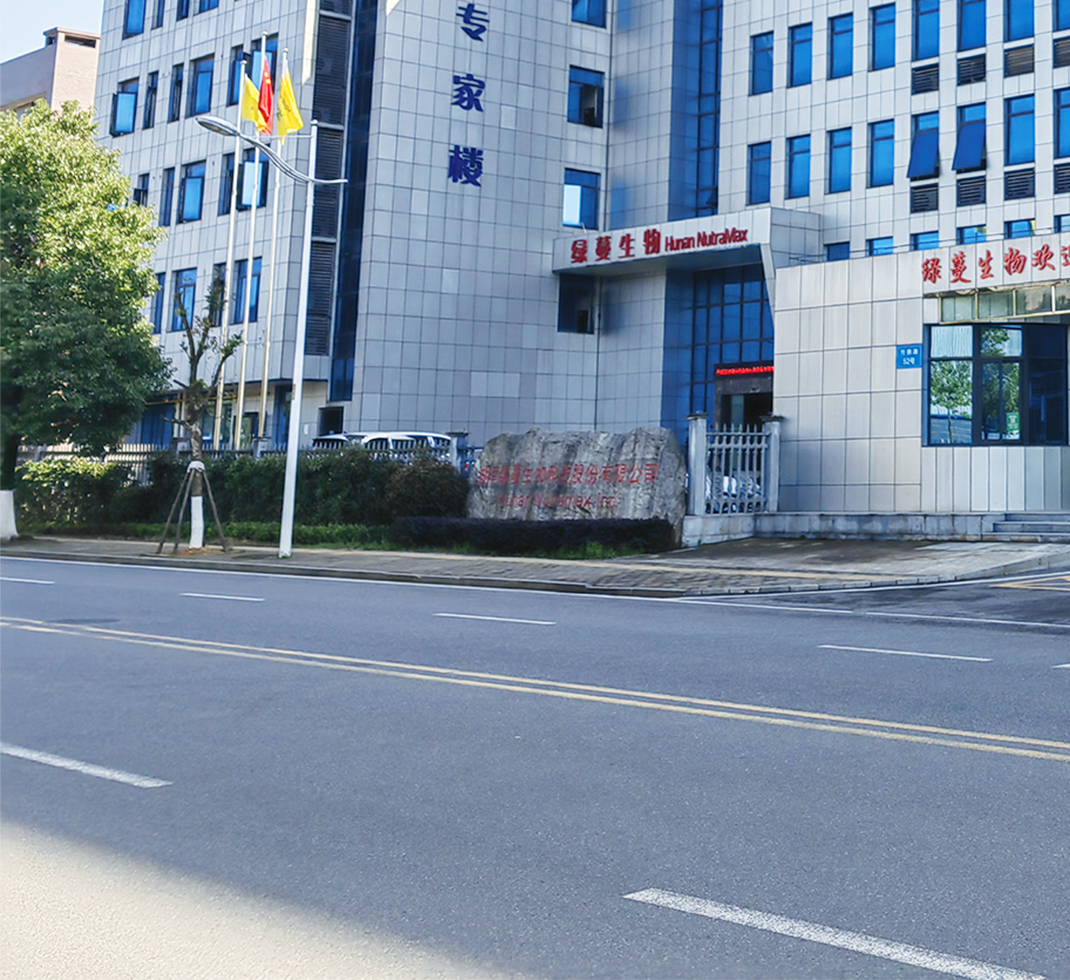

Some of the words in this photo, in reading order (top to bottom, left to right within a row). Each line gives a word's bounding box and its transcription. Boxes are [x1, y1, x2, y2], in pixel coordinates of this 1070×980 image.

[447, 3, 490, 187] 专家楼
[571, 228, 661, 264] 绿蔓生物
[665, 235, 695, 252] Hunan
[697, 227, 748, 248] NutraMax
